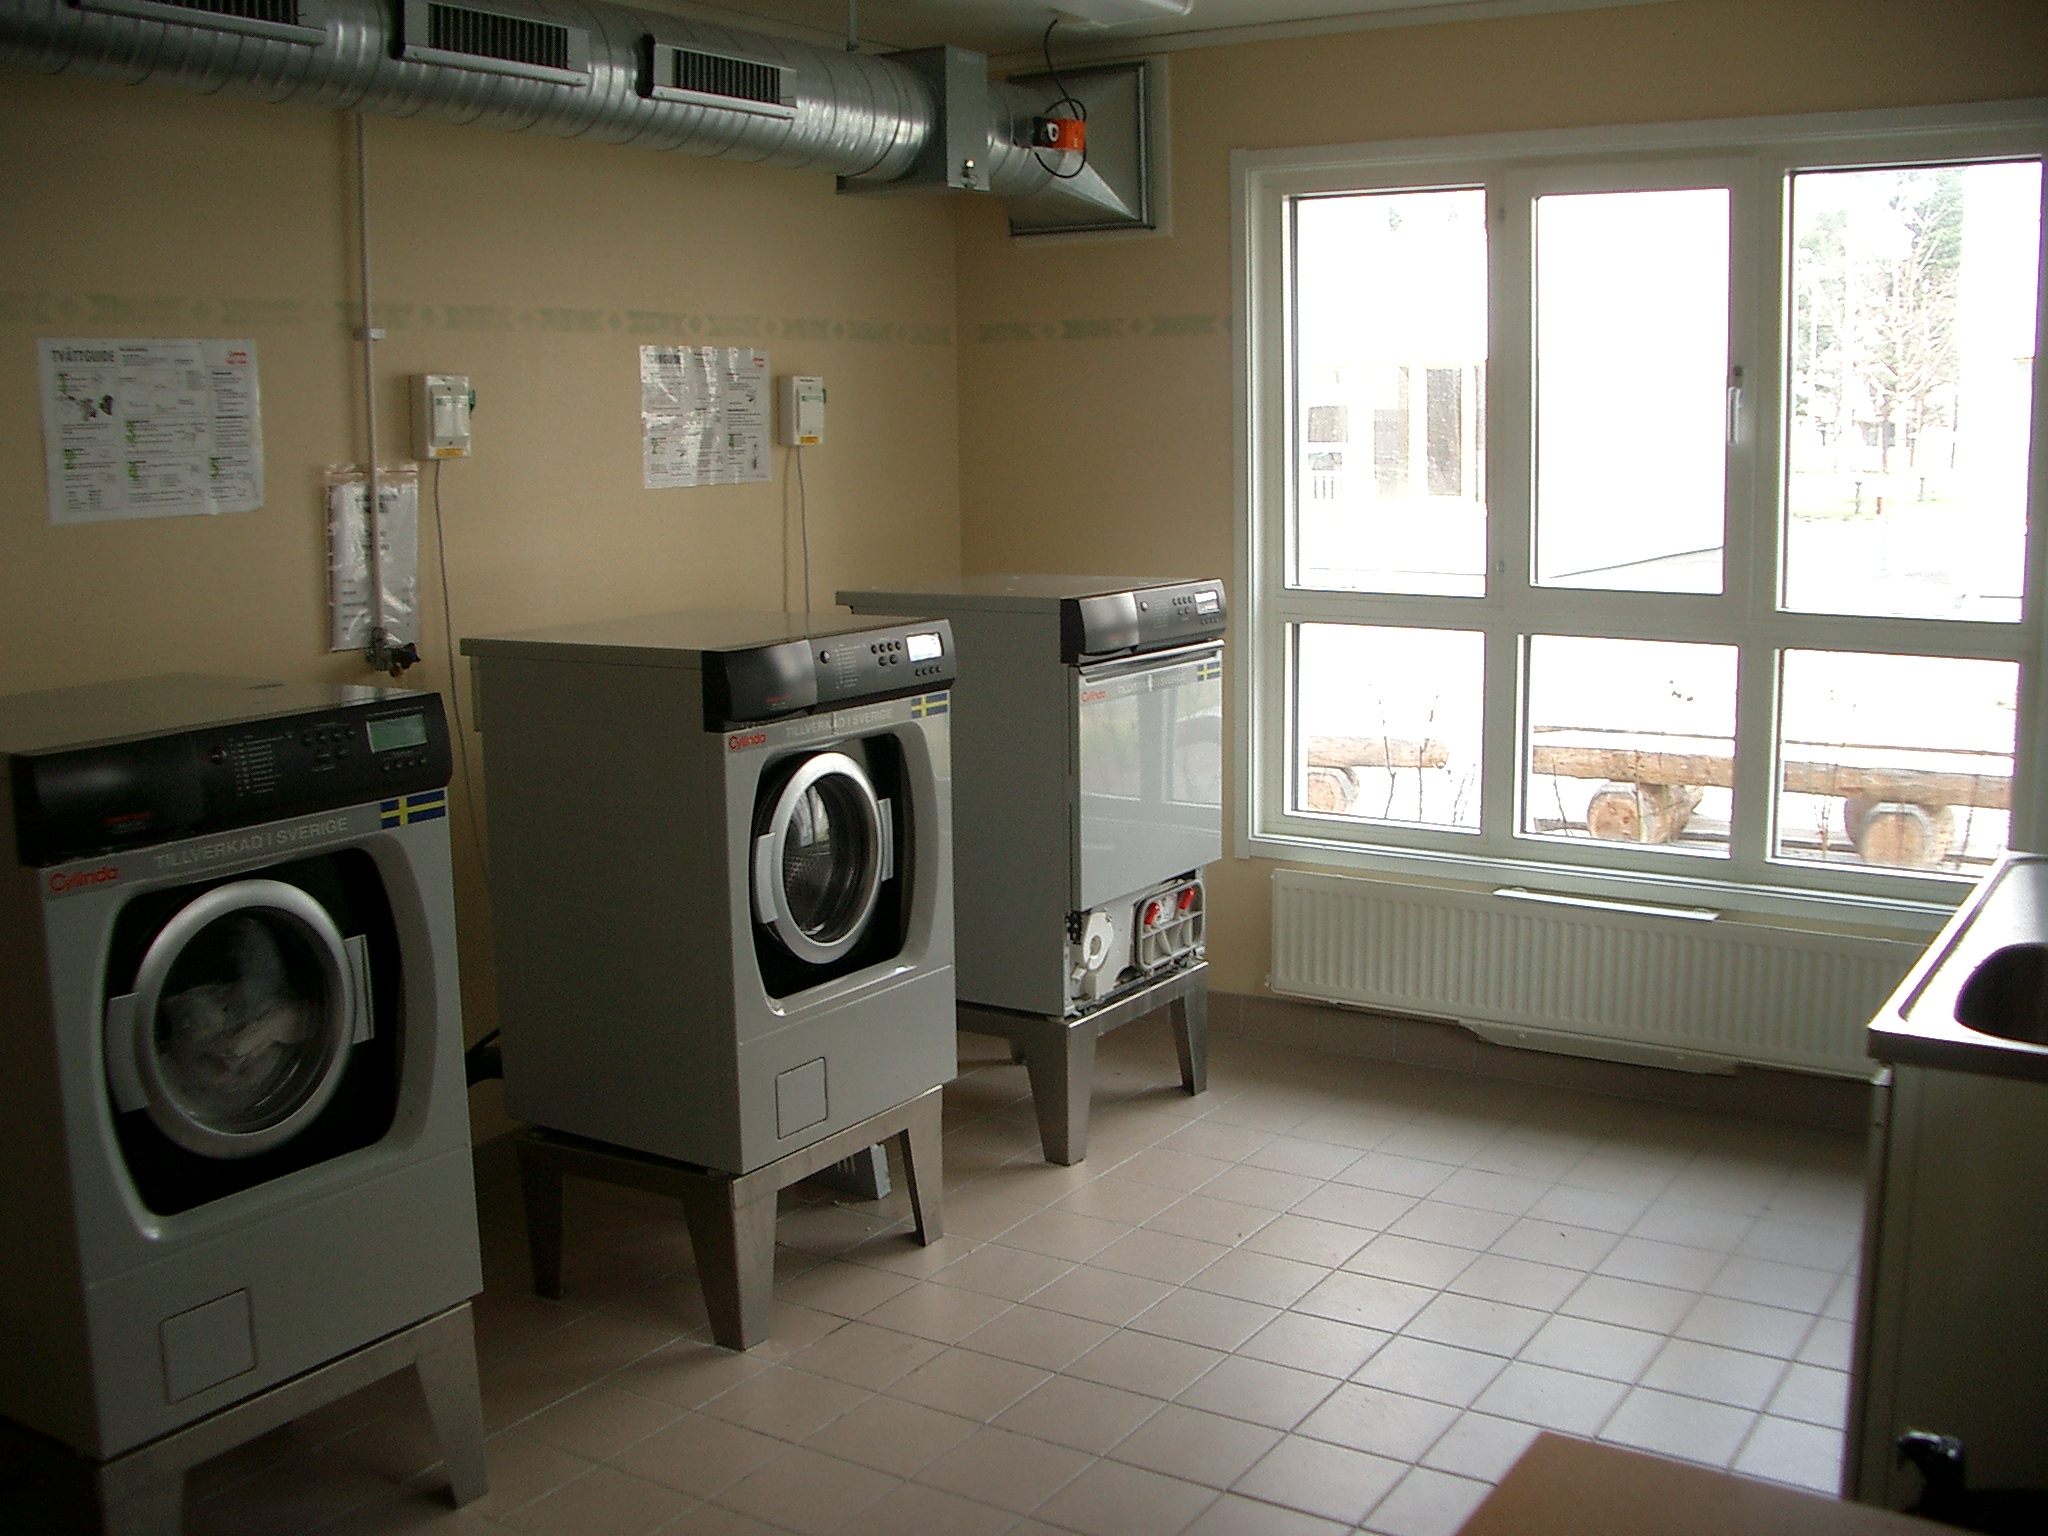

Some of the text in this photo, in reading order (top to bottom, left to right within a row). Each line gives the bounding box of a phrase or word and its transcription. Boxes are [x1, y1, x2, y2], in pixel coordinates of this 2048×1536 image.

[154, 834, 262, 869] TILLVERKAD
[276, 817, 348, 844] SVERIGE
[48, 866, 119, 892] Cylinda
